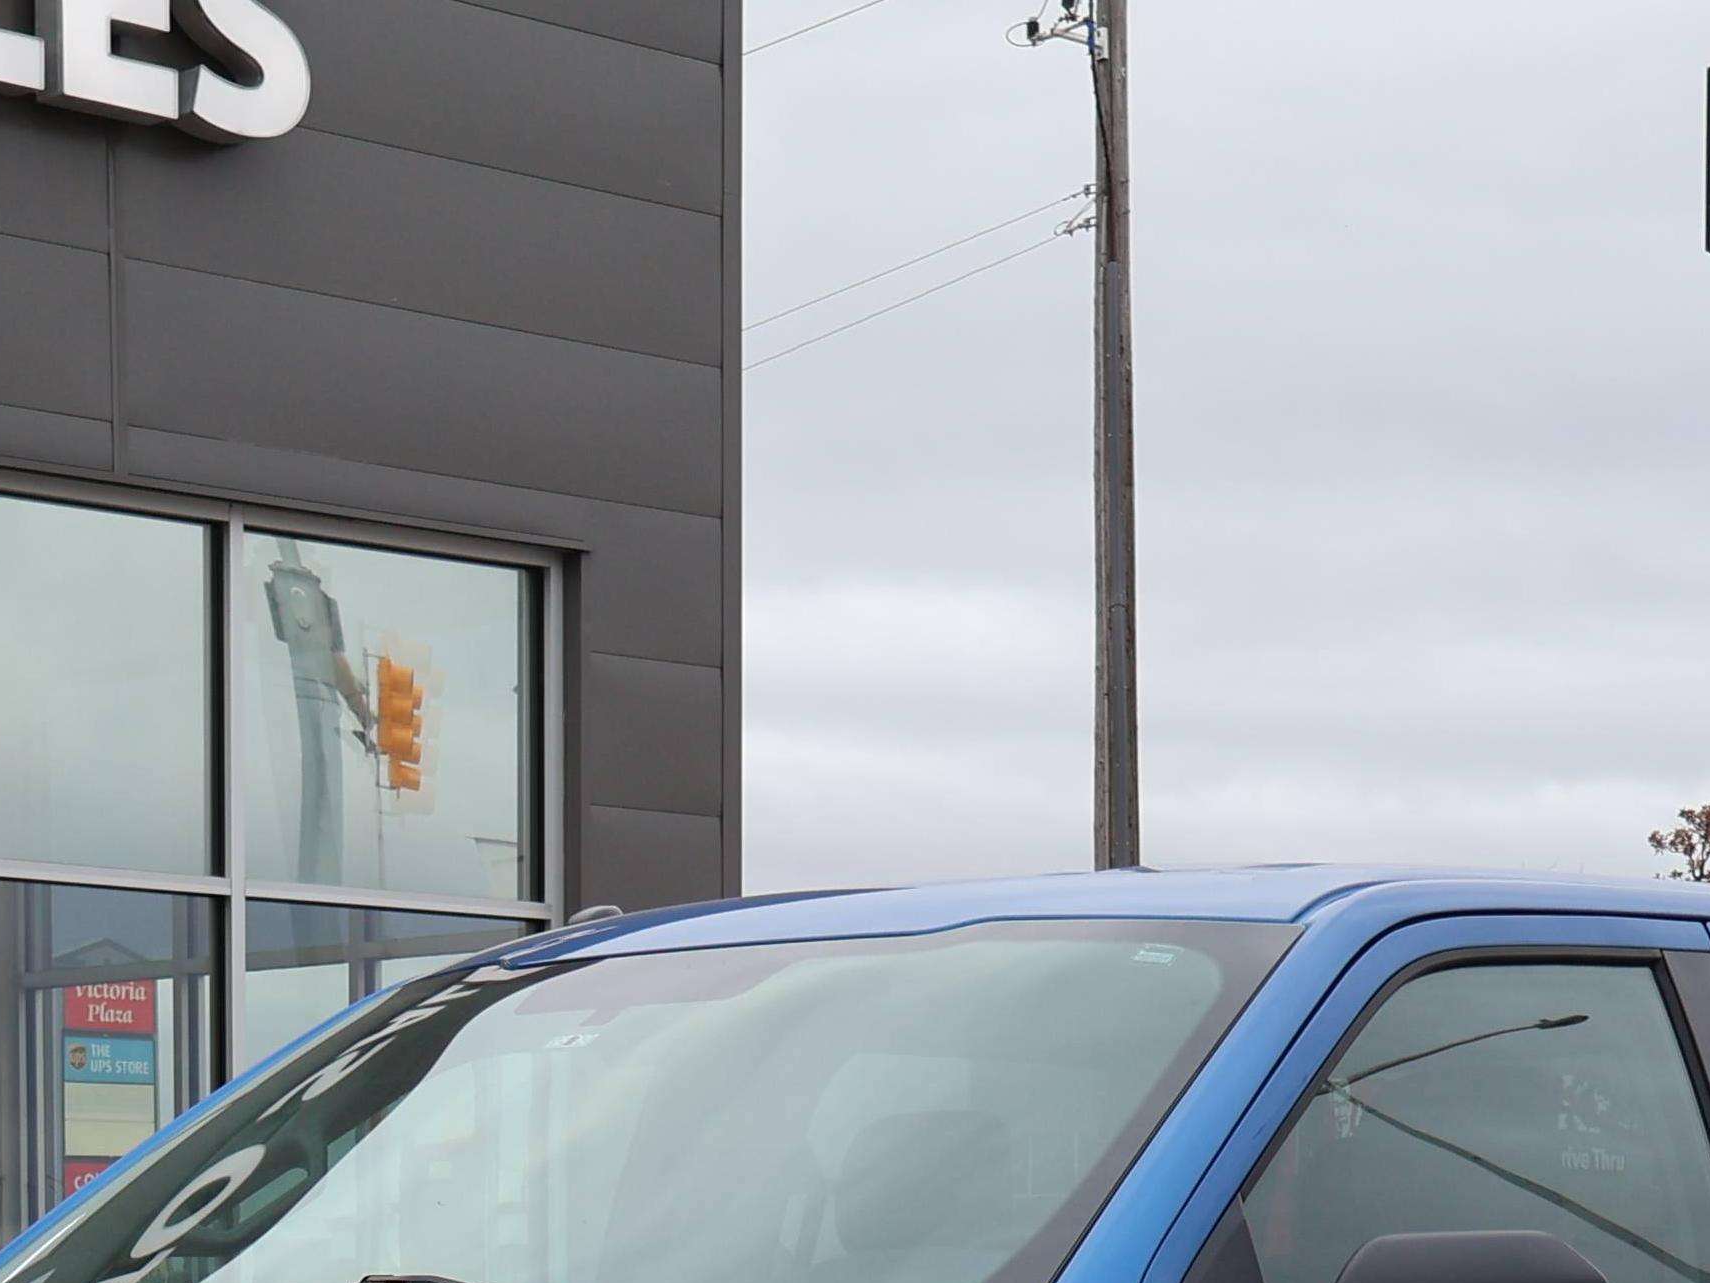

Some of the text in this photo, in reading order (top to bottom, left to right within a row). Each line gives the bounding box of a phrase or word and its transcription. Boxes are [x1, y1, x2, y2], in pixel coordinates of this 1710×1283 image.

[87, 1002, 133, 1024] Plaza
[91, 1044, 110, 1058] THE
[91, 1060, 149, 1075] UPS STORE
